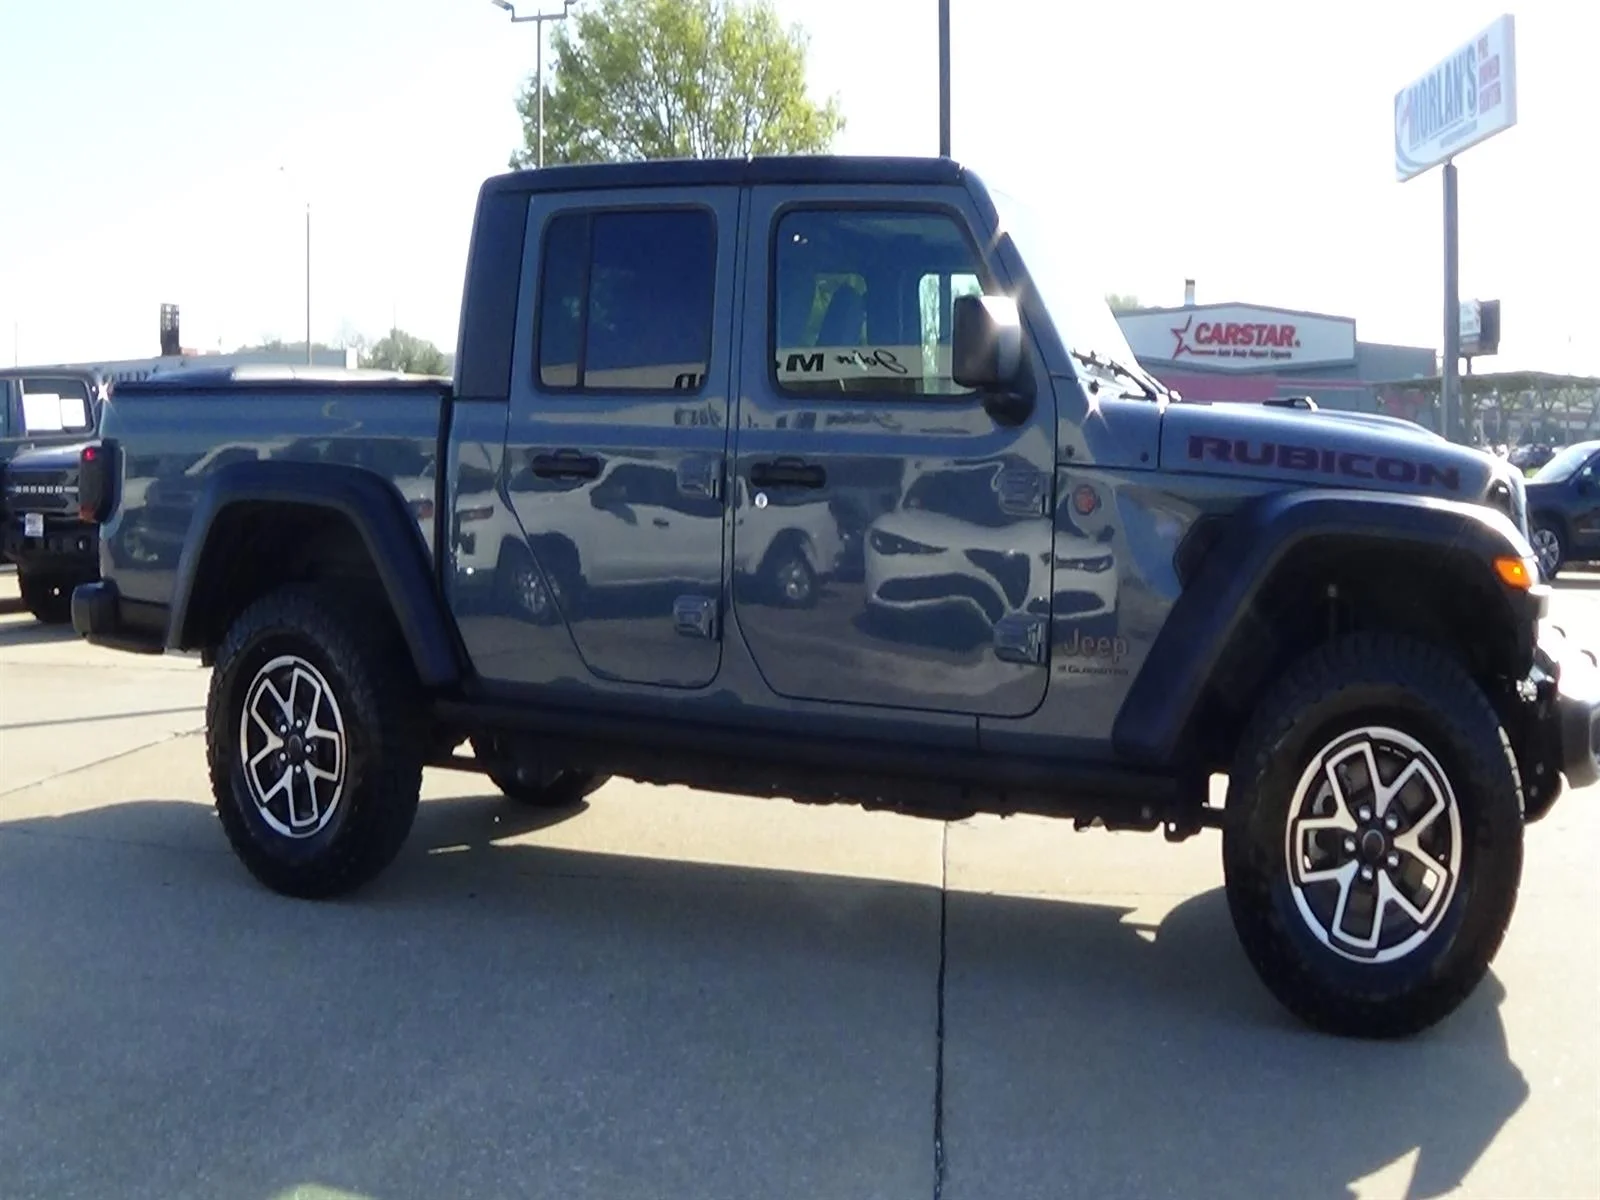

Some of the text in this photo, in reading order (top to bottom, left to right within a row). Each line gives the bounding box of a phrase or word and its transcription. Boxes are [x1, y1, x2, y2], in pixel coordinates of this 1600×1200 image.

[1195, 322, 1296, 347] CARSTAR
[1187, 435, 1460, 491] RUBICON
[1063, 627, 1129, 664] Jeep
